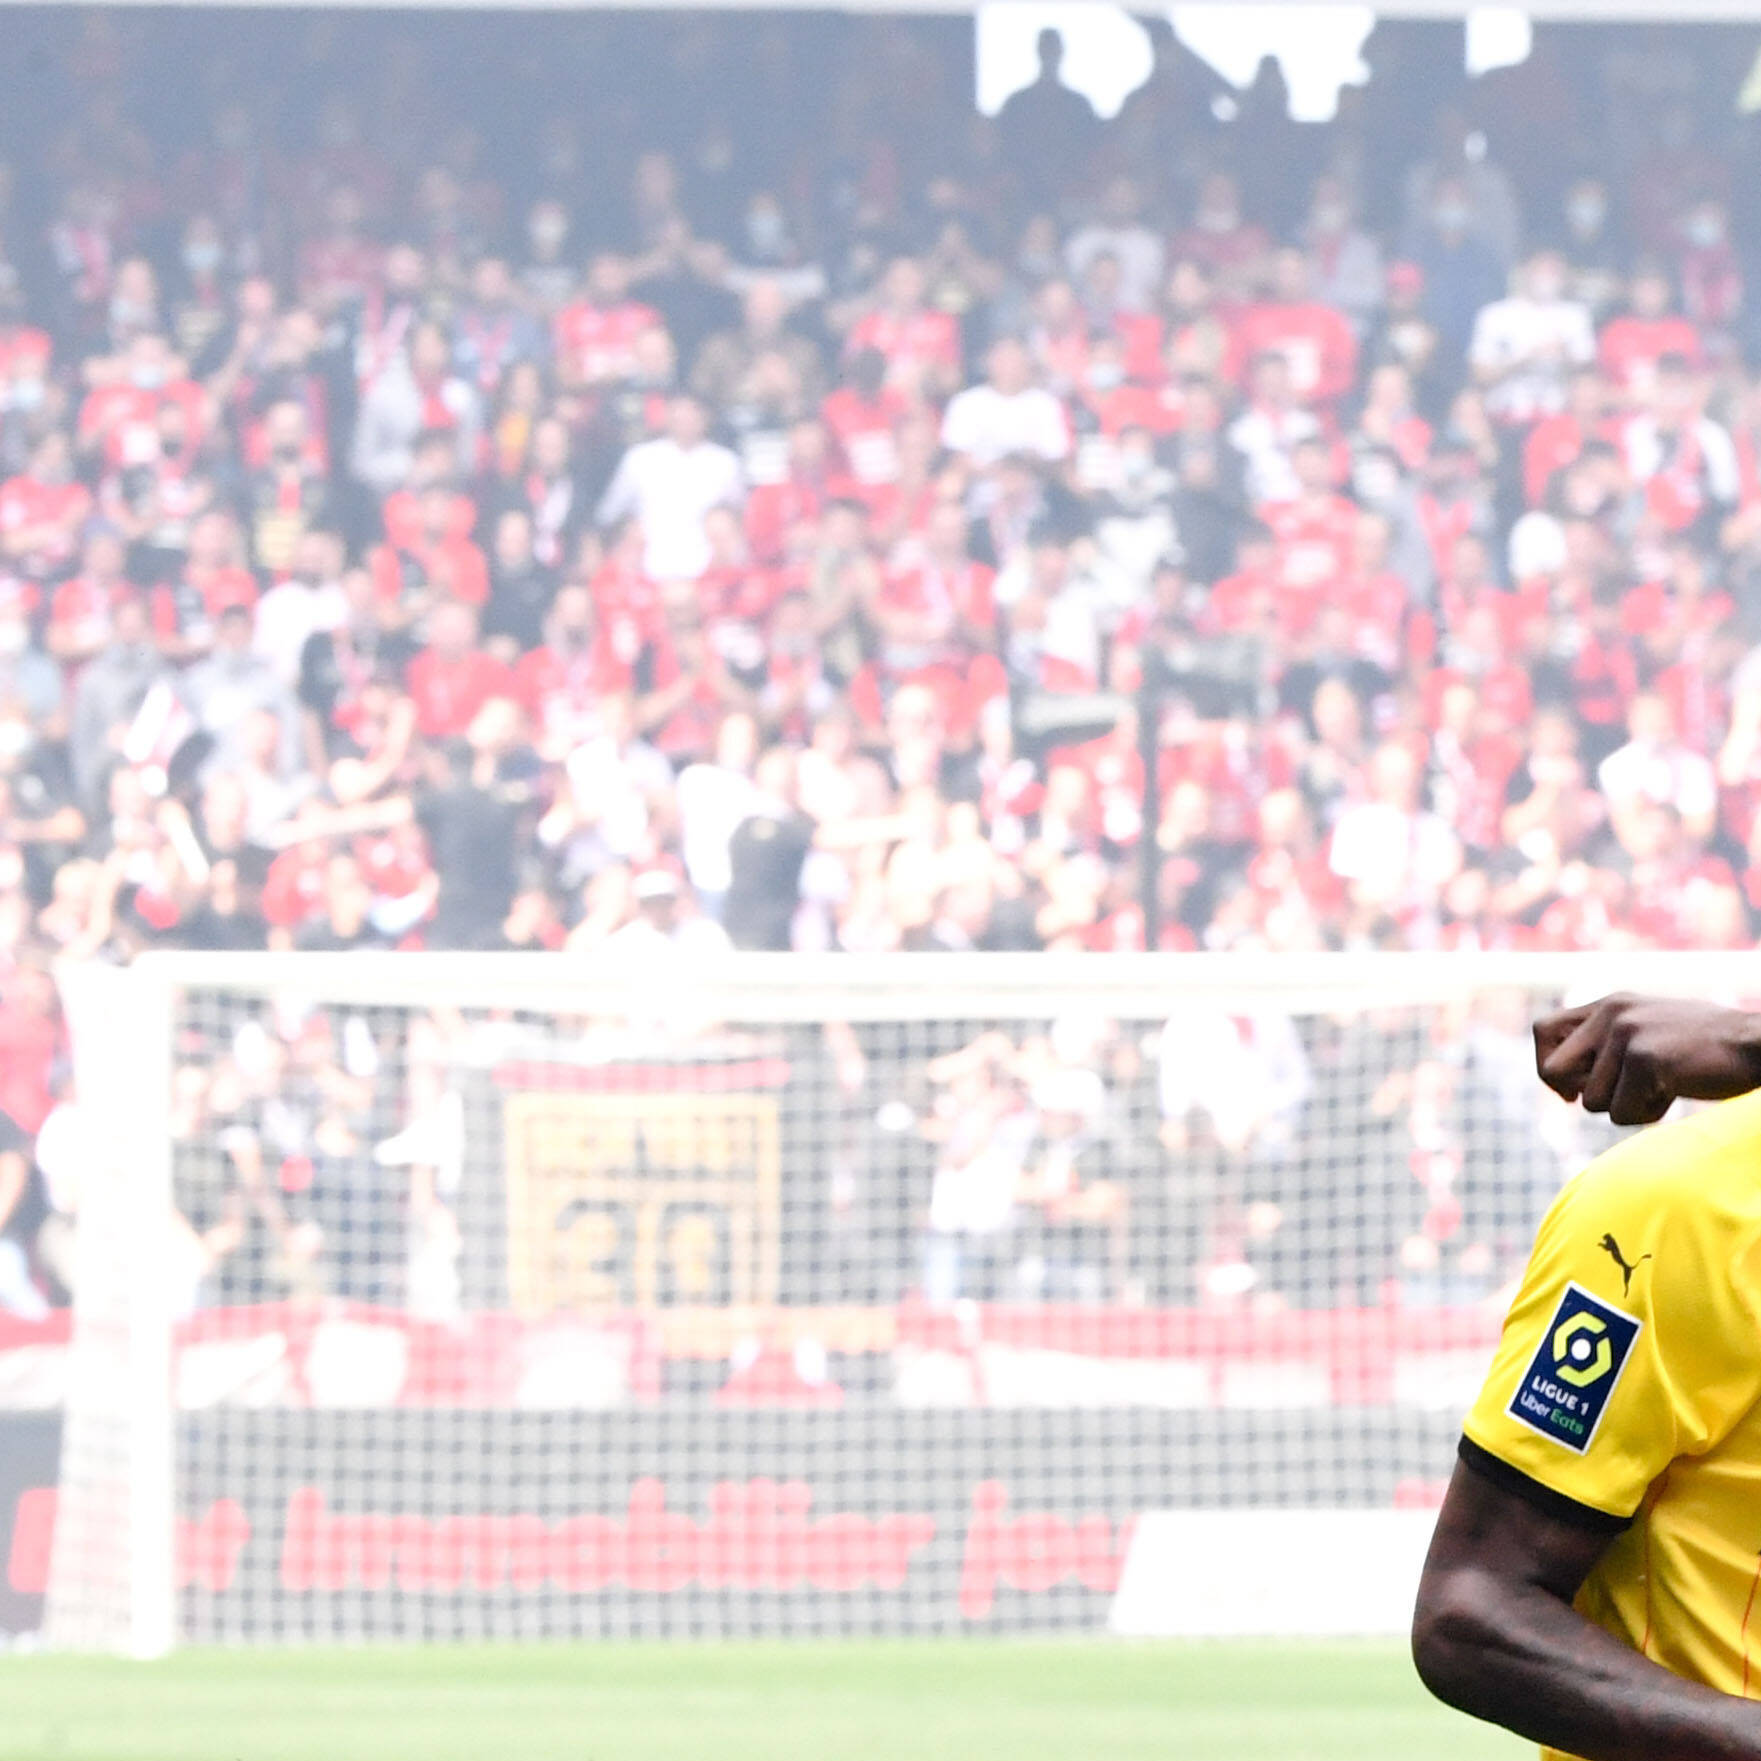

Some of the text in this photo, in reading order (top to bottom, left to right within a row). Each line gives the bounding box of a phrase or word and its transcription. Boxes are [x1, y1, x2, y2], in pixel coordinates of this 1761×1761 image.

[1520, 1389, 1585, 1435] Uber Eats
[1531, 1375, 1590, 1417] LIGUE 1
